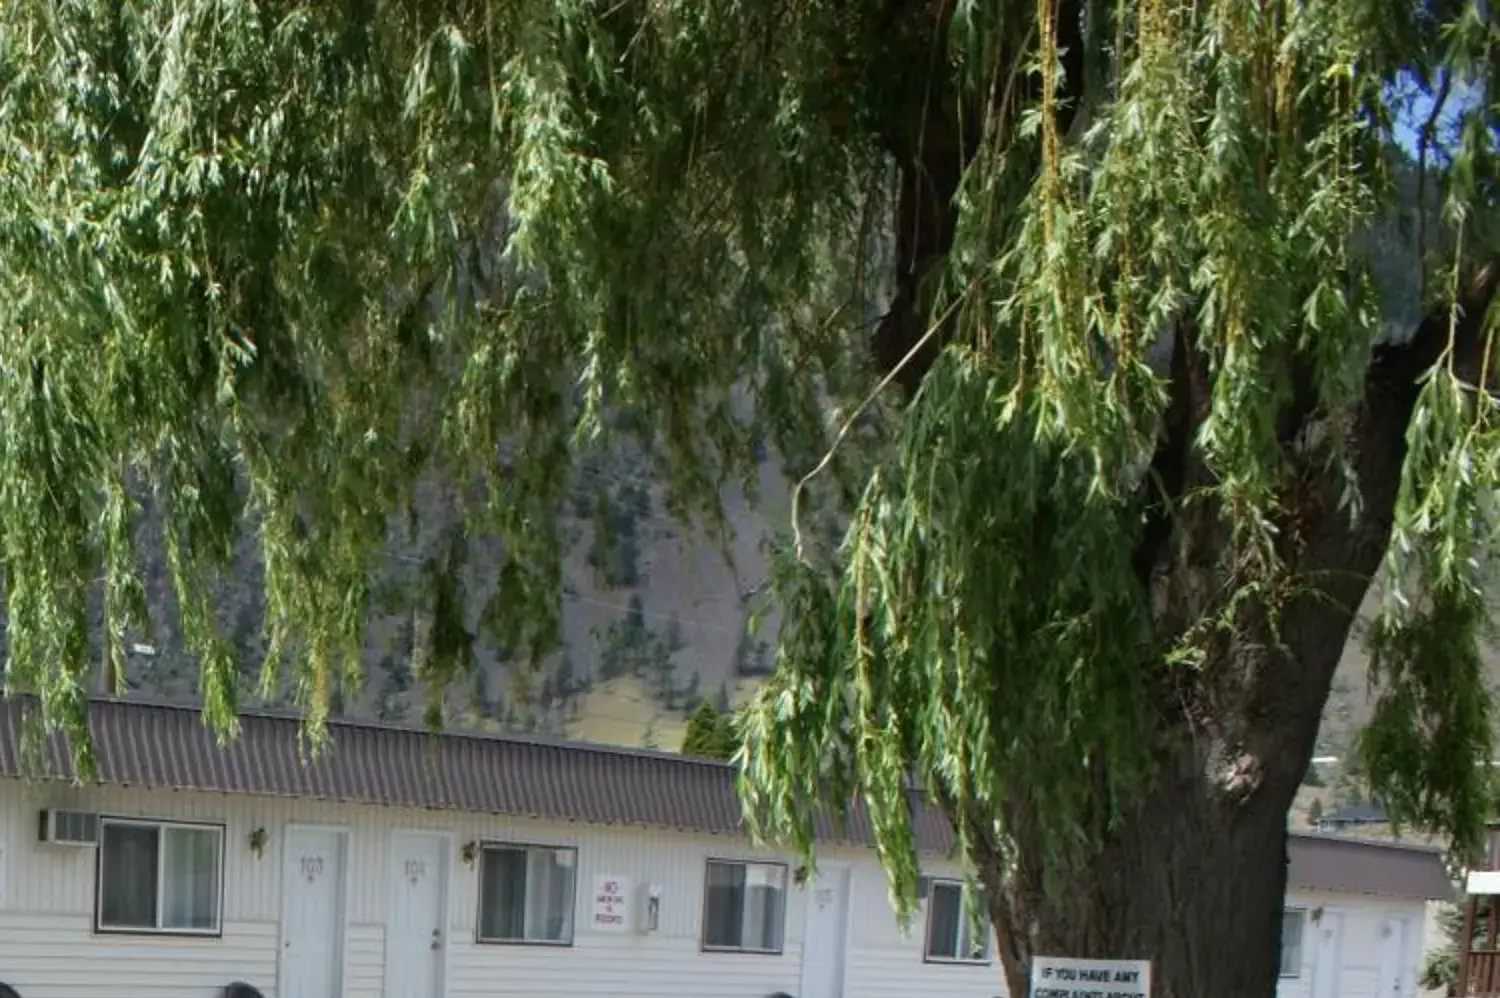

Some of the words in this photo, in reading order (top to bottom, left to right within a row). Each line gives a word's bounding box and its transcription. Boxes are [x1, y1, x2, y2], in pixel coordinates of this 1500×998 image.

[1041, 967, 1053, 978] IF
[1055, 968, 1076, 980] YOU
[1079, 970, 1110, 982] HAVE
[1113, 971, 1140, 983] ANY
